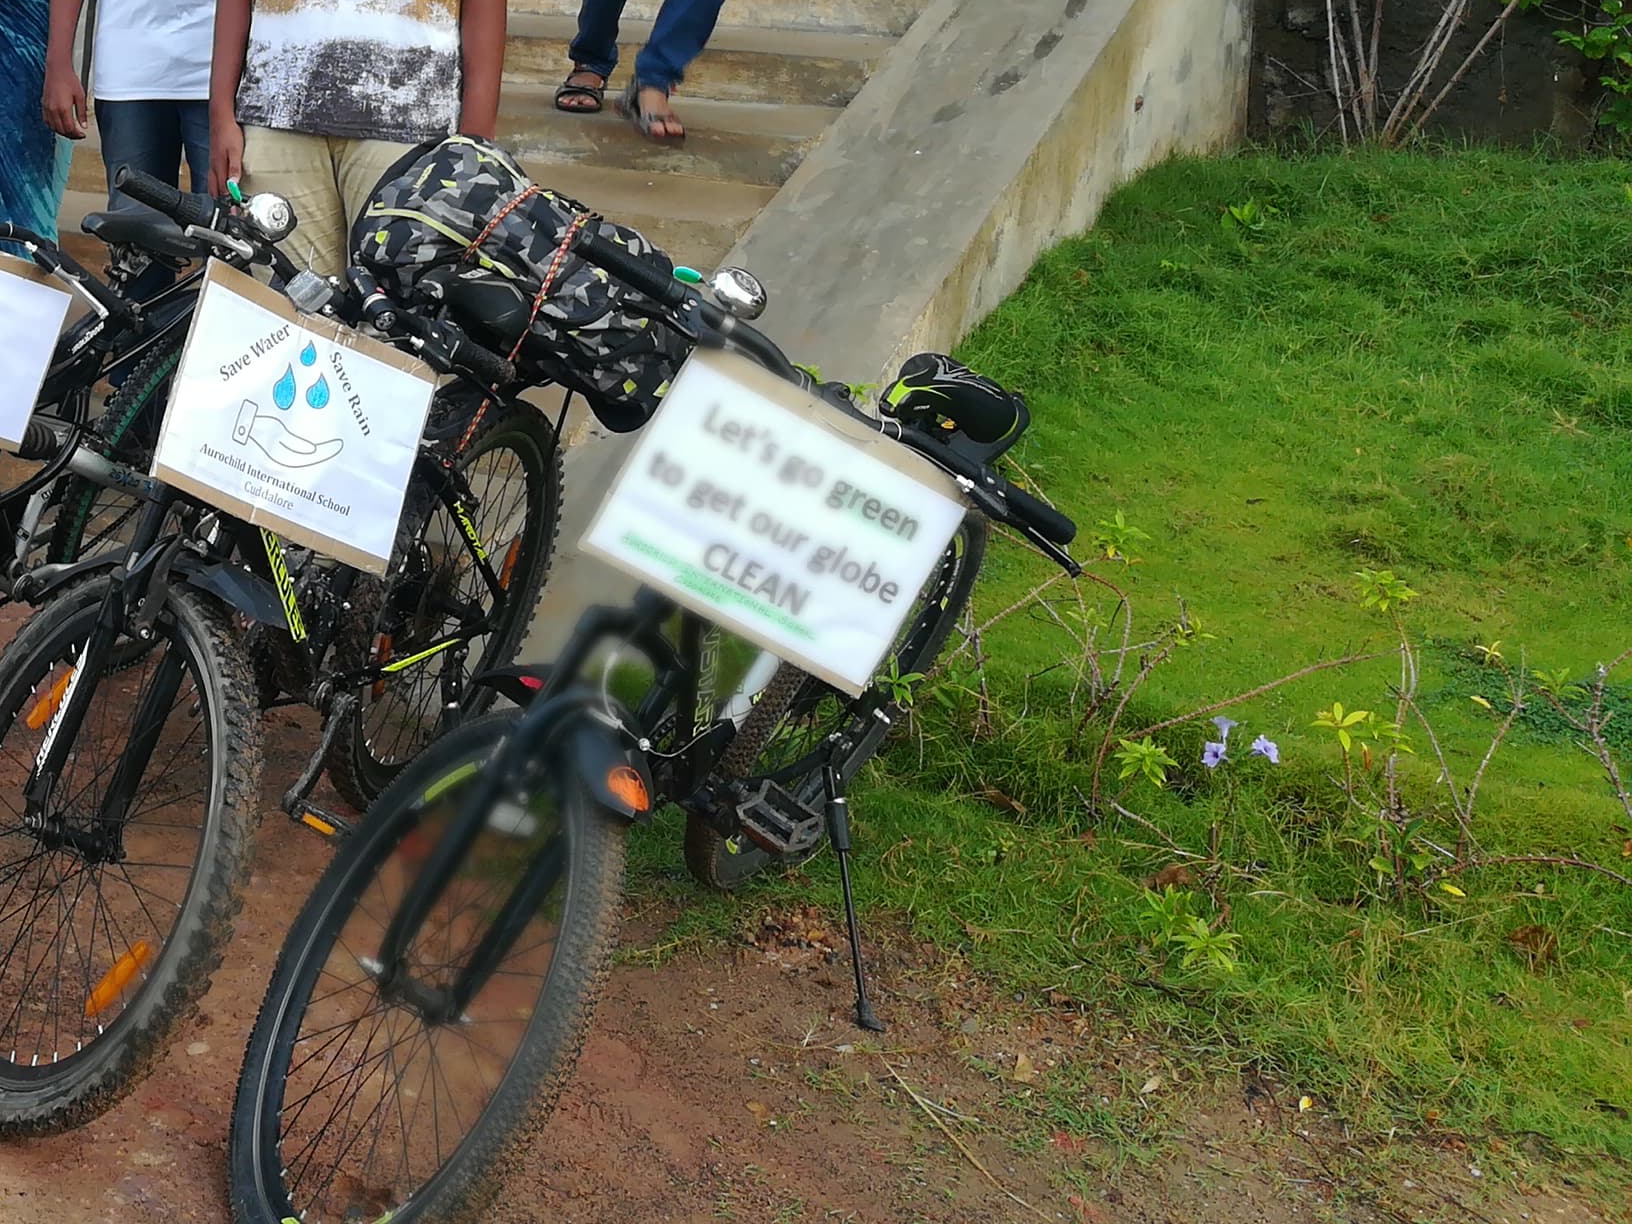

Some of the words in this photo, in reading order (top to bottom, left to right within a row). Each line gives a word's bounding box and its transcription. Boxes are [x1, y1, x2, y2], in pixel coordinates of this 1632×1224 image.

[219, 353, 252, 382] Save
[250, 324, 292, 357] Water
[329, 351, 352, 393] Save
[348, 395, 372, 437] Rain
[199, 443, 247, 473] Aurochild
[247, 464, 319, 502] International
[317, 494, 351, 517] School
[244, 480, 294, 511] Cuddalore
[701, 401, 777, 466] Let's
[778, 448, 826, 491] go
[824, 476, 921, 544] green
[647, 447, 686, 488] to
[686, 478, 745, 523] get
[749, 507, 811, 556] our
[807, 539, 901, 607] globe
[701, 540, 813, 618] CLEAN
